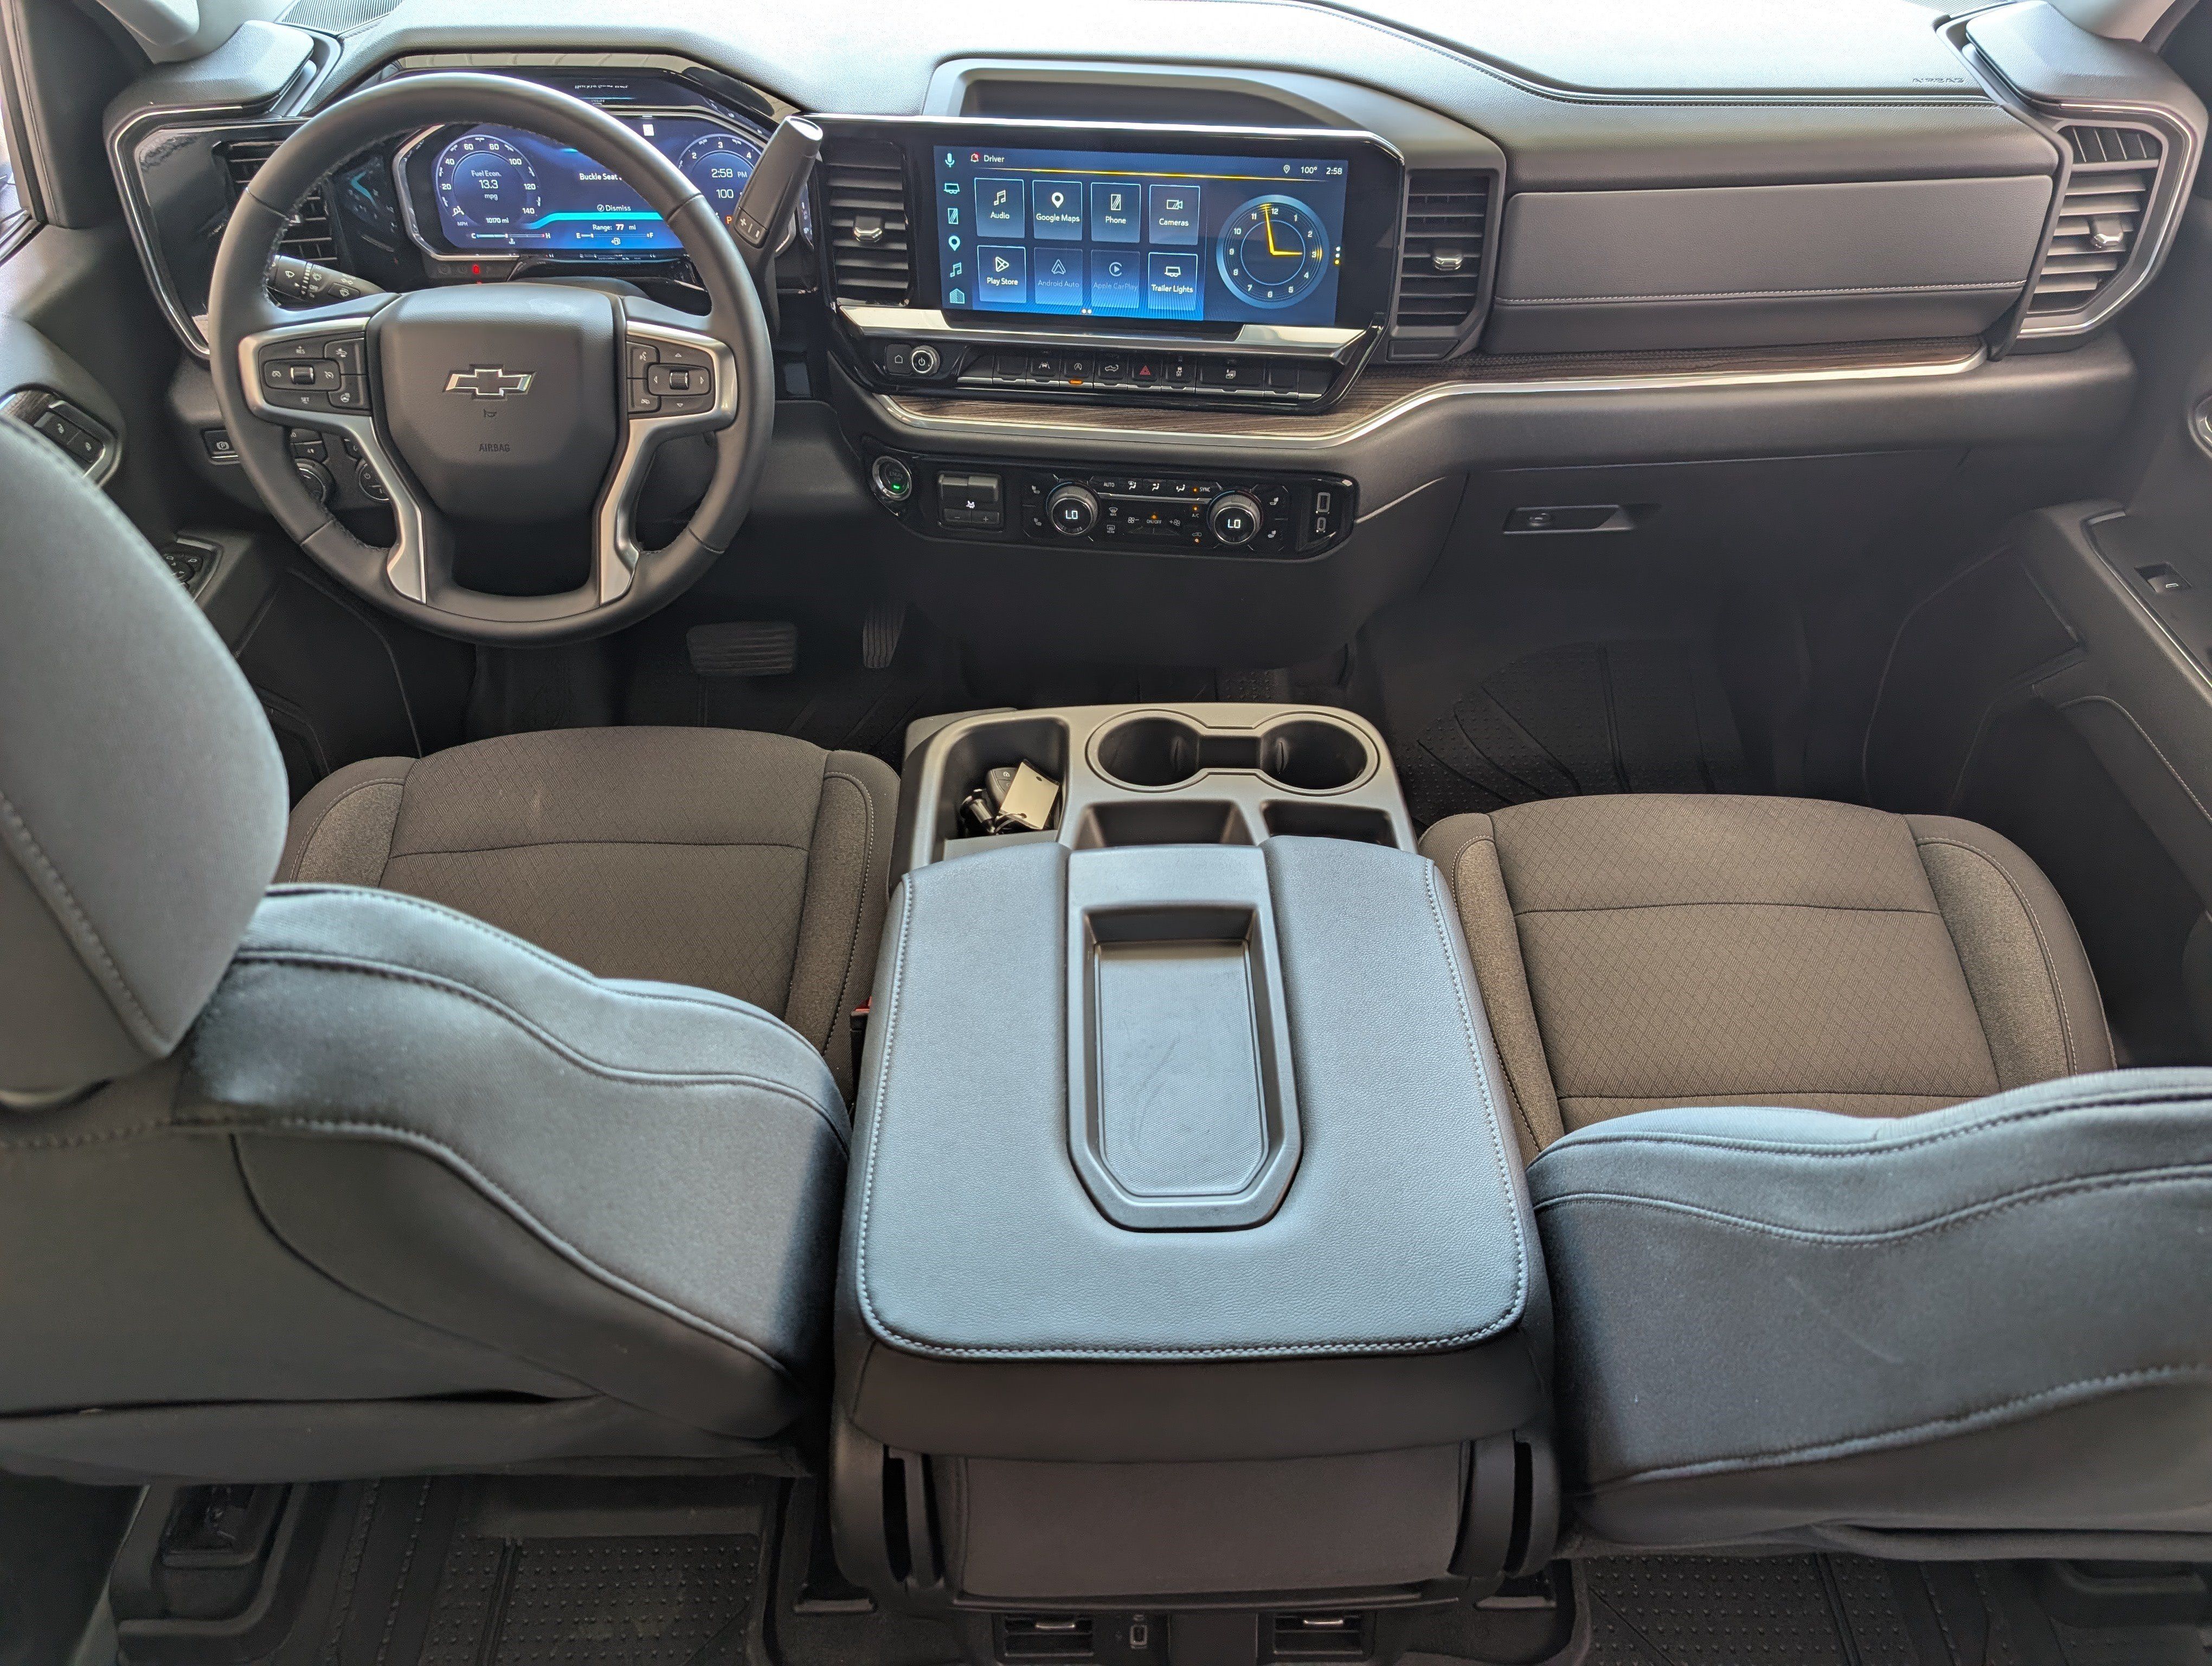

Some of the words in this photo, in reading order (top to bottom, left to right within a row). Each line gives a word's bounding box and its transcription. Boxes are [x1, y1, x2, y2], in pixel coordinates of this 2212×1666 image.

[983, 155, 1005, 163] Driver
[711, 168, 733, 178] 2:58
[1300, 165, 1317, 174] 100°
[1326, 167, 1342, 175] 2:58
[579, 172, 602, 181] Buckle
[602, 172, 619, 181] Seat
[479, 180, 499, 189] 13.3
[716, 189, 734, 198] 100
[1036, 213, 1060, 223] Google
[1061, 214, 1080, 223] Maps
[1105, 215, 1127, 224] Phone
[1159, 218, 1189, 227] Cameras
[592, 223, 613, 232] Range:
[987, 277, 1000, 286] Play
[1001, 278, 1018, 286] Store
[1151, 283, 1172, 292] Trailer
[1173, 285, 1194, 294] Lights
[478, 443, 511, 452] AIRBAG
[1065, 510, 1078, 520] LO
[1227, 518, 1241, 529] LO
